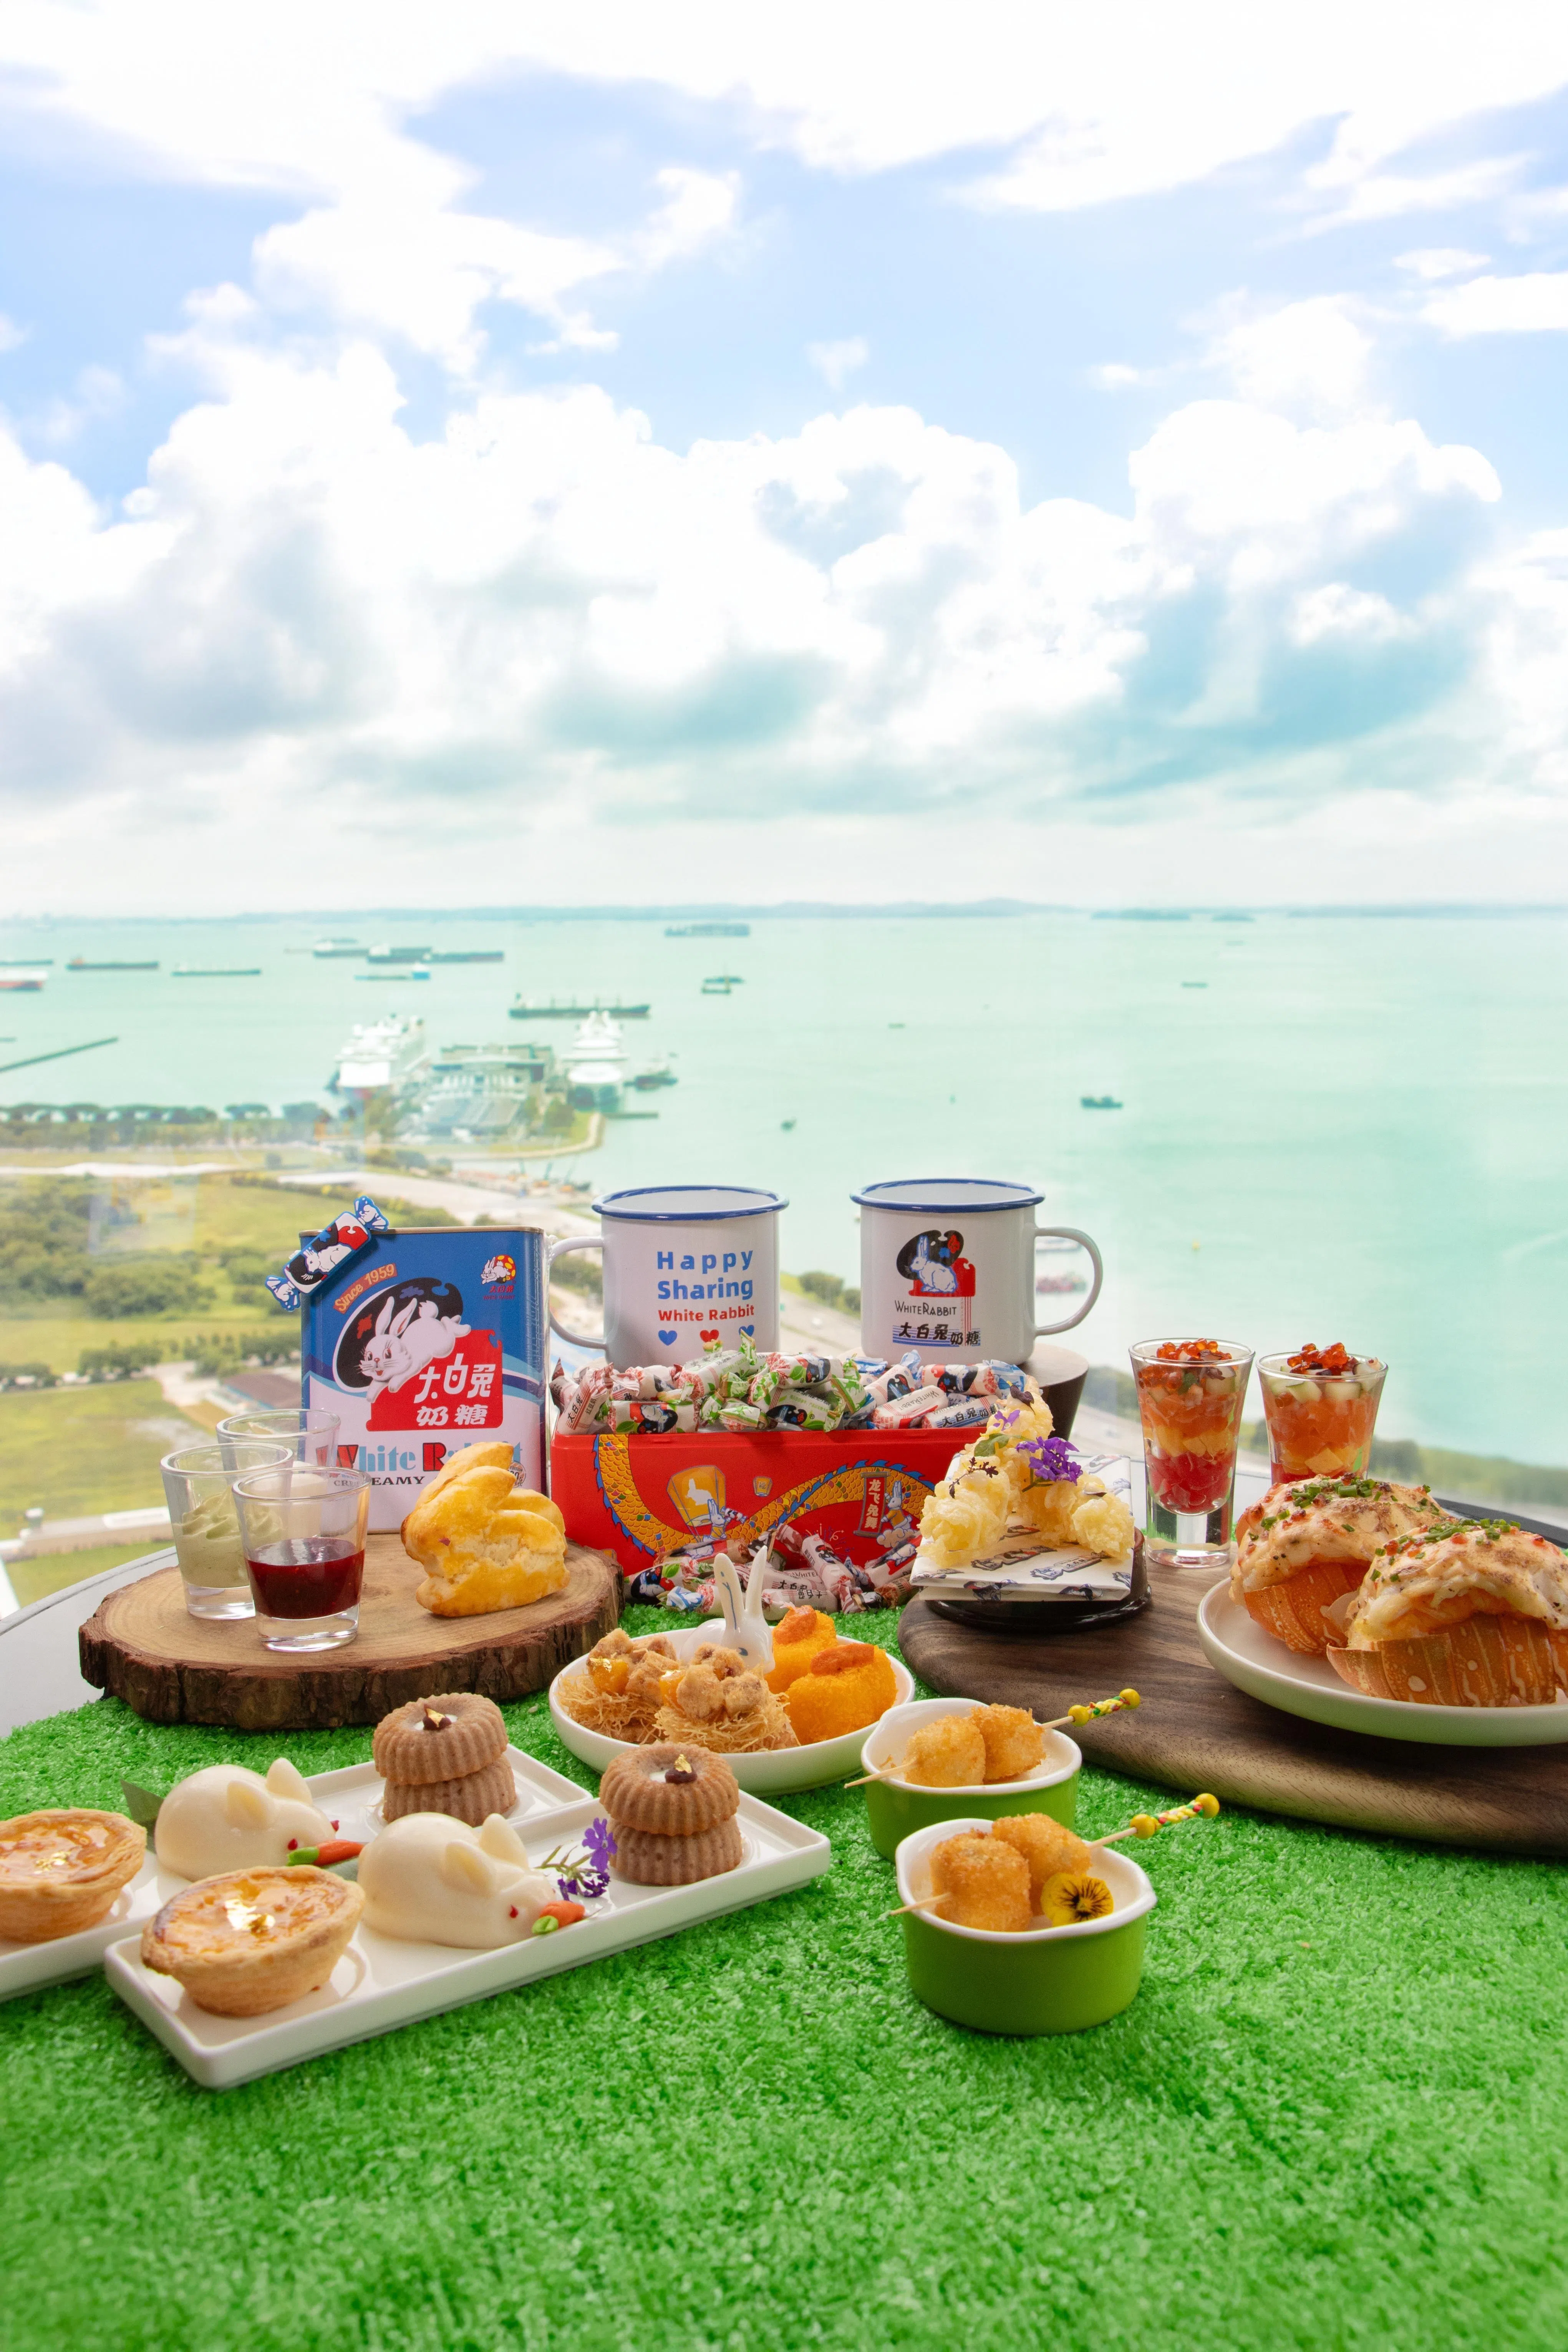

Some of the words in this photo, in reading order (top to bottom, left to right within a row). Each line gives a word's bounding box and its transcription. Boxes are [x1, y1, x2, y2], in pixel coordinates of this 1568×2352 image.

[657, 1250, 753, 1274] Happy
[335, 1284, 363, 1311] Since
[365, 1264, 394, 1285] 1959
[658, 1277, 753, 1300] Sharing
[658, 1309, 704, 1321] White
[709, 1304, 754, 1320] Rabbit
[414, 1353, 496, 1404] 大白兔
[416, 1404, 488, 1426] 奶糖
[568, 1394, 583, 1423] 大白兔
[864, 1479, 881, 1529] 龙飞兔舞
